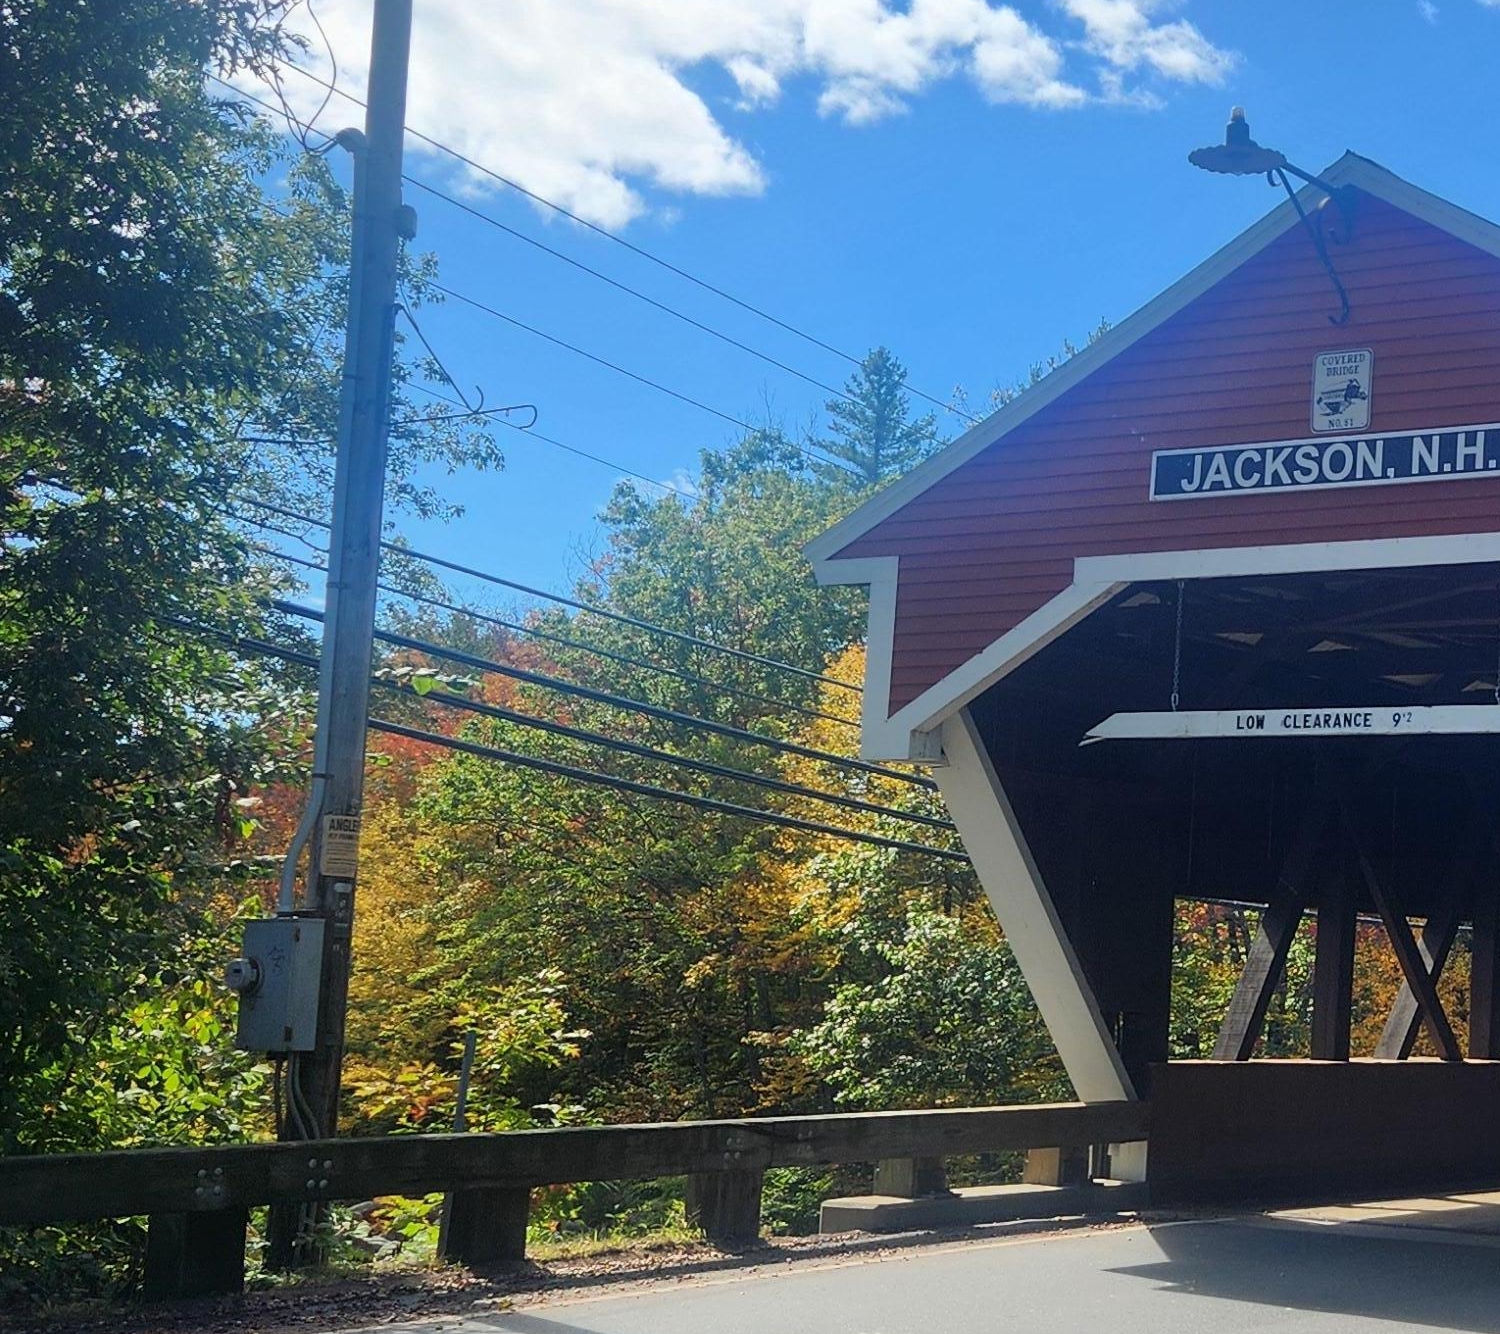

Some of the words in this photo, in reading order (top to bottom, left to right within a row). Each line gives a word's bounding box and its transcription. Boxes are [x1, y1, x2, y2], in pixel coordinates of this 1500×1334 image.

[1321, 354, 1366, 366] COVERED
[1326, 365, 1360, 377] BRIDGE
[1180, 439, 1396, 493] JACKSON,
[1411, 431, 1498, 474] N.H.
[1236, 714, 1265, 730] LOW
[1282, 712, 1373, 729] CLEARANCE
